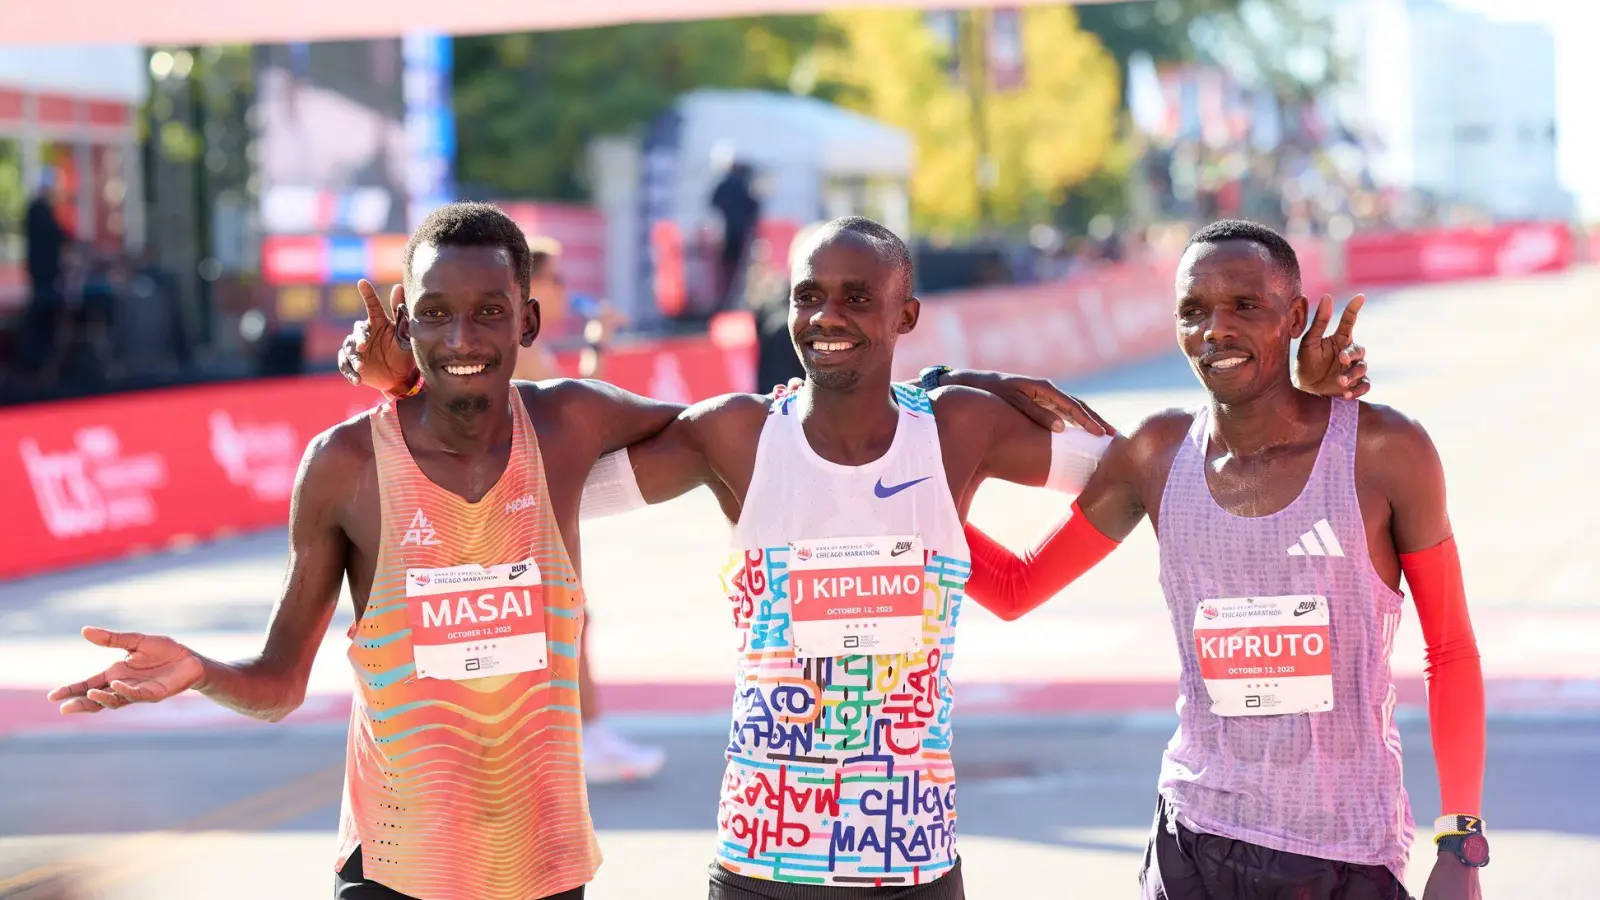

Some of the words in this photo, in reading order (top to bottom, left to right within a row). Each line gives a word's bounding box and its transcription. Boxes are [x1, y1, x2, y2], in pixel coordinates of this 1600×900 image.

[896, 542, 912, 550] RUN
[816, 551, 843, 559] CHICAGO
[845, 549, 880, 557] MARATHON
[511, 564, 527, 573] RUN
[434, 576, 461, 585] CHICAGO
[463, 575, 498, 583] MARATHON
[794, 579, 804, 605] J
[813, 574, 920, 599] KIPLIMO
[421, 590, 533, 628] MASAI
[827, 607, 861, 616] OCTOBER
[863, 606, 874, 614] 12,
[876, 605, 893, 613] 2025
[1298, 601, 1317, 610] RUN
[1222, 611, 1247, 619] CHICAGO
[1248, 609, 1282, 617] MARATHON
[447, 630, 480, 639] OCTOBER
[483, 628, 493, 636] 12,
[495, 626, 511, 634] 2025
[1200, 633, 1324, 659] KIPRUTO
[1228, 667, 1262, 675] OCTOBER
[1264, 666, 1275, 674] 12,
